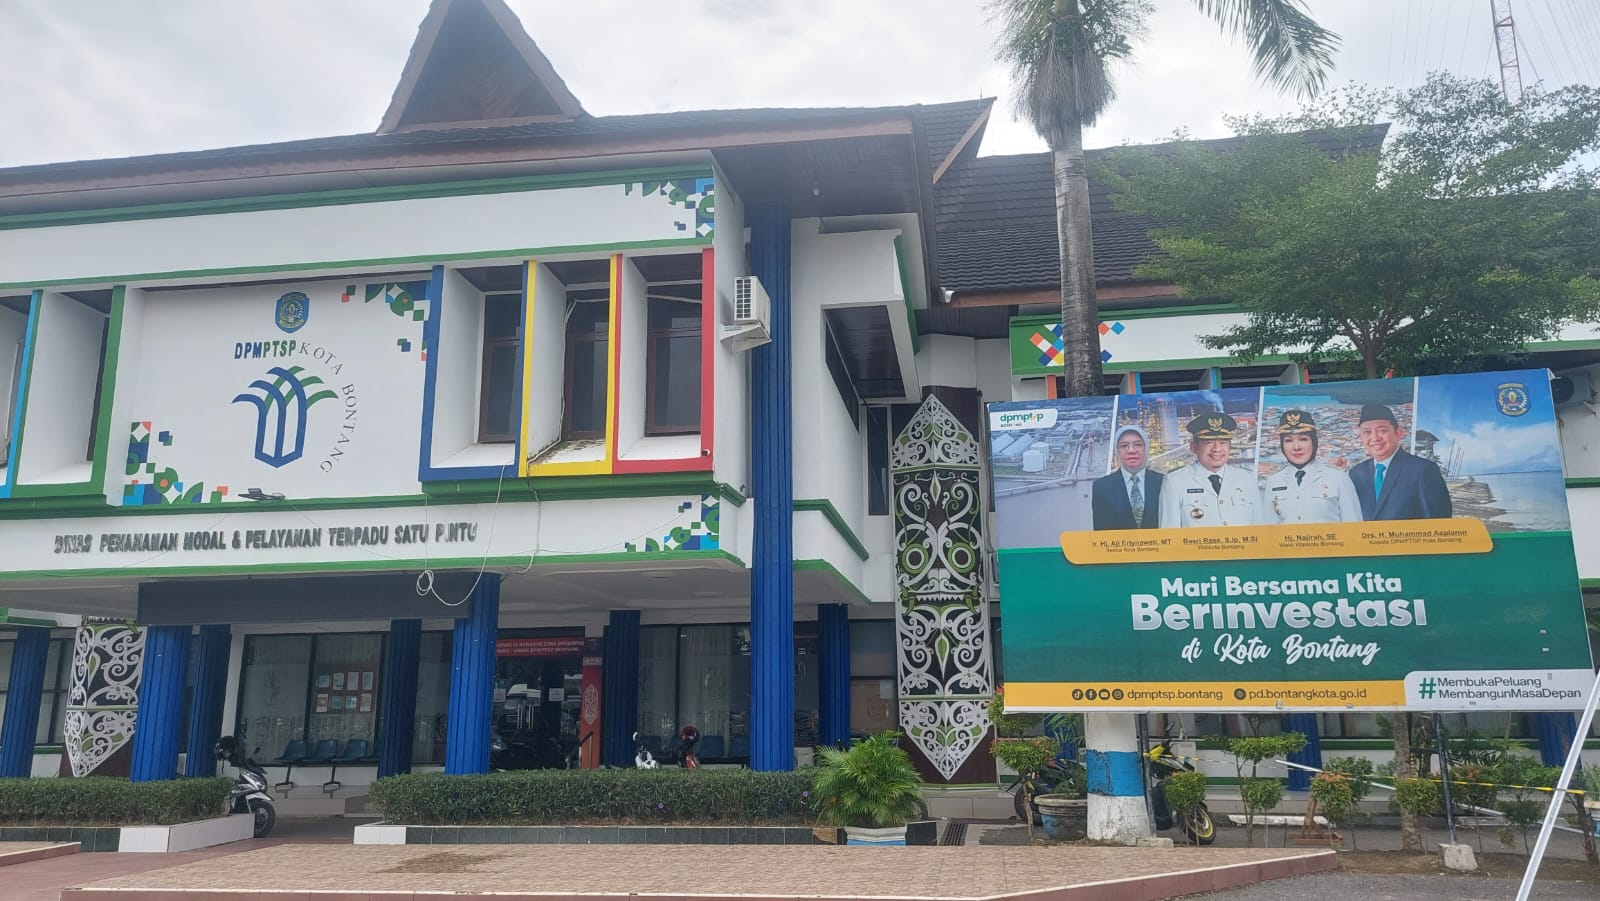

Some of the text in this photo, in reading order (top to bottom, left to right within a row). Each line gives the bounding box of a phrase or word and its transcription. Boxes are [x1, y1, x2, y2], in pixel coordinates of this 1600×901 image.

[234, 340, 296, 359] DPMPTSP
[299, 342, 358, 473] KOTA BONTANG
[99, 533, 179, 552] PENANAMAN
[183, 531, 226, 550] MODAL
[232, 530, 241, 549] &
[245, 528, 321, 548] PELAYANAN
[329, 525, 389, 546] TERPADU
[394, 523, 429, 544] SATU
[436, 522, 477, 543] PNTU
[1388, 530, 1432, 538] Muhammad
[1161, 572, 1402, 597] Mari Bersama Kita
[1130, 594, 1427, 630] Berinvestasi
[1182, 634, 1380, 666] di Kota Bontang
[1127, 688, 1367, 701] dpmptsp.bontang pd.bontangkota.go.id
[1439, 688, 1582, 700] MembangunMasaDepan
